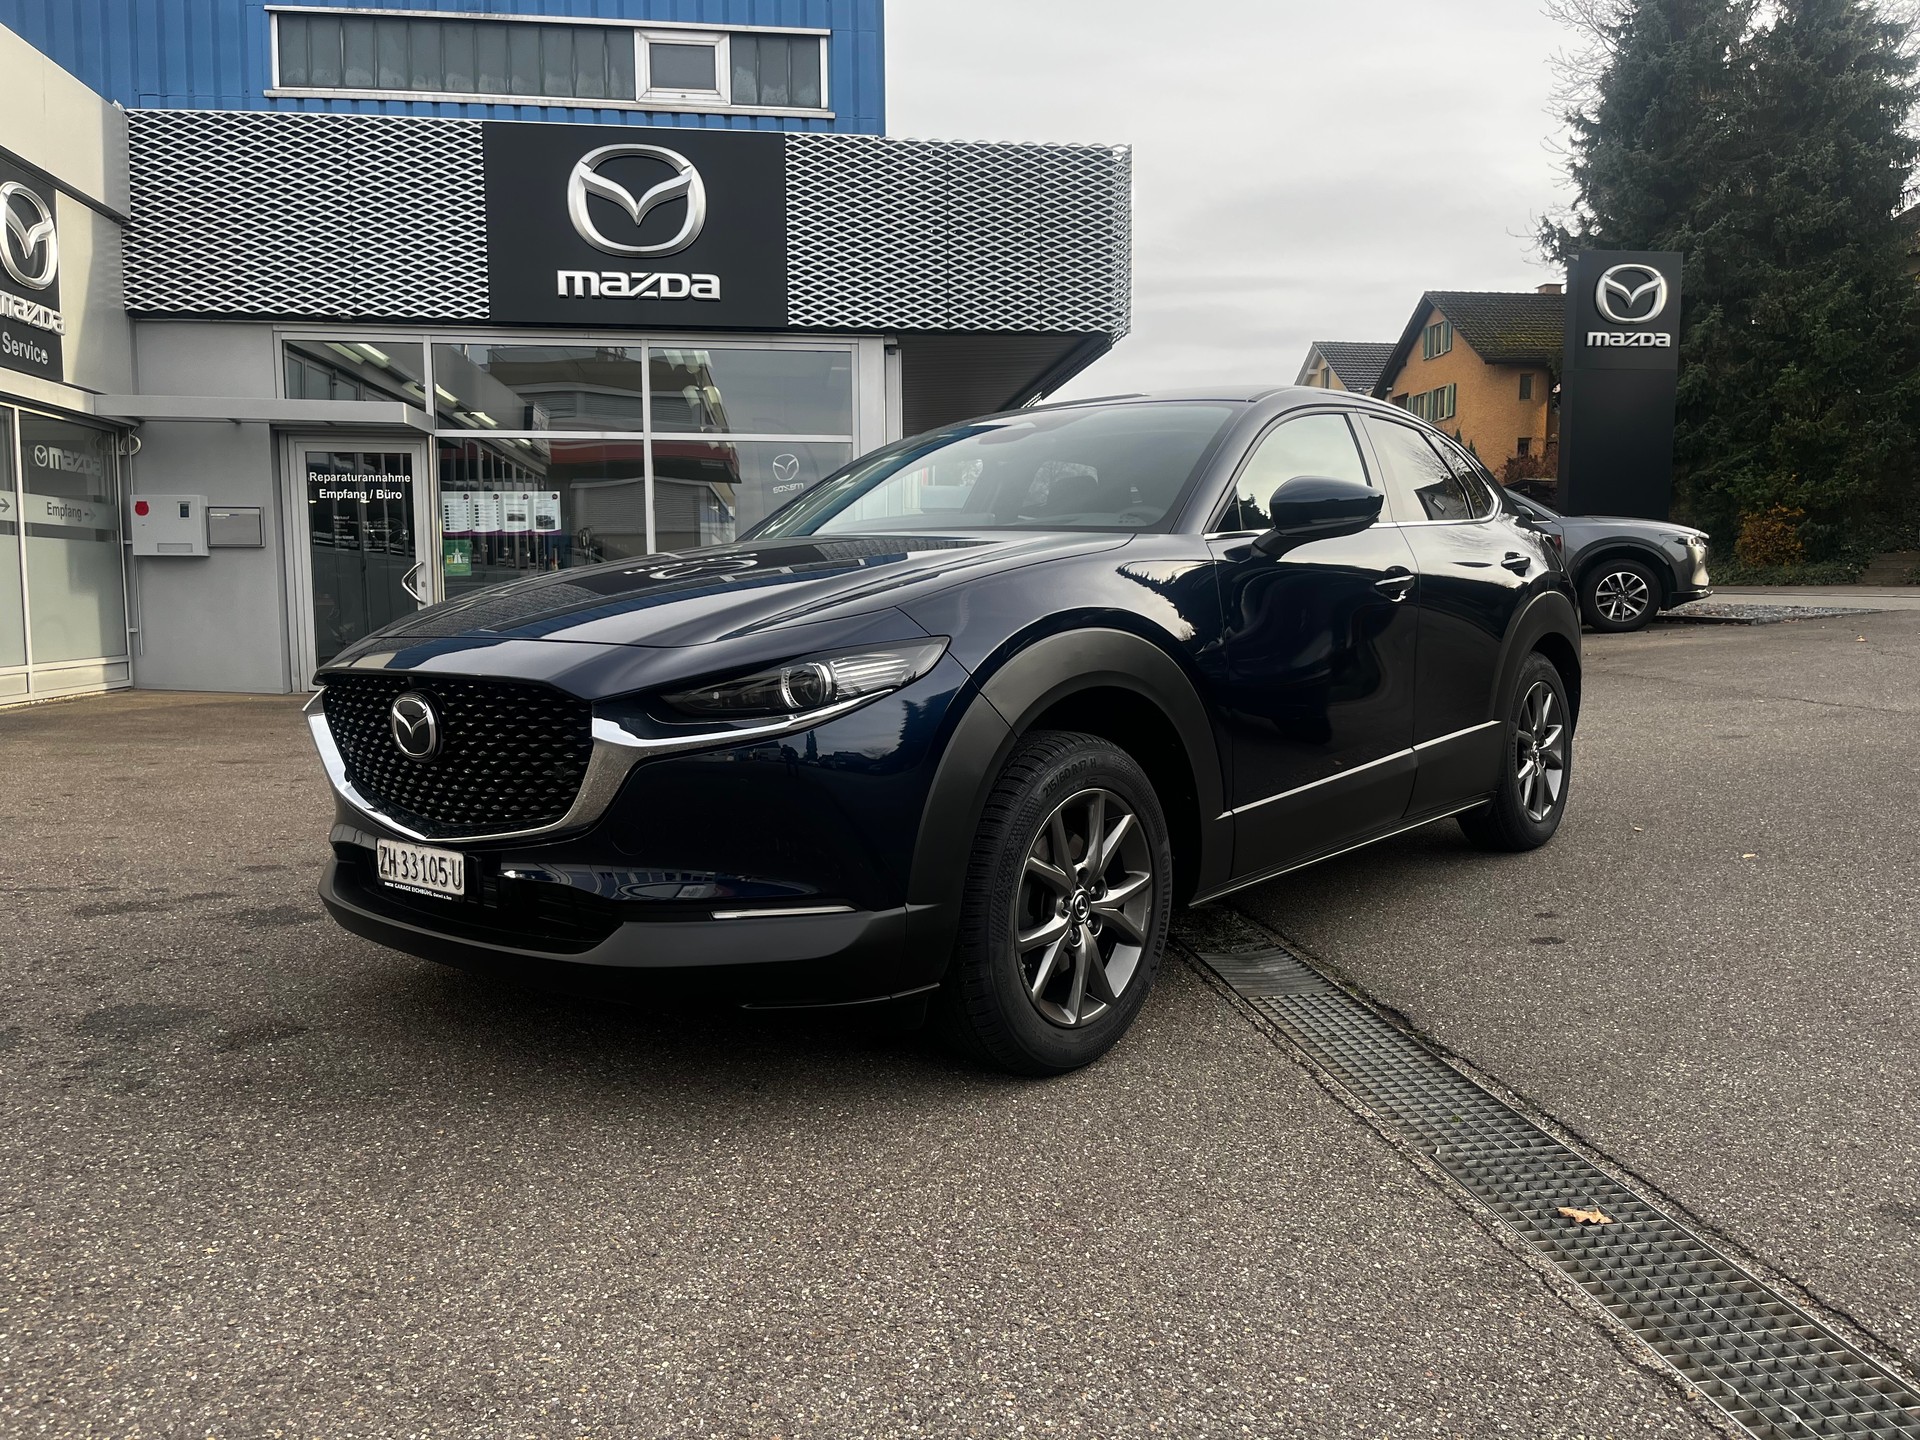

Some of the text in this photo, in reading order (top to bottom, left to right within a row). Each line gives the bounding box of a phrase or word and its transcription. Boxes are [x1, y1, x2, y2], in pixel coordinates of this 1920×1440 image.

[557, 270, 721, 301] mazda
[2, 331, 49, 365] Service
[1587, 331, 1671, 347] mazda
[309, 472, 411, 485] Reparaturannahme
[319, 489, 403, 501] Empfang / Büro
[46, 501, 83, 522] Empfang
